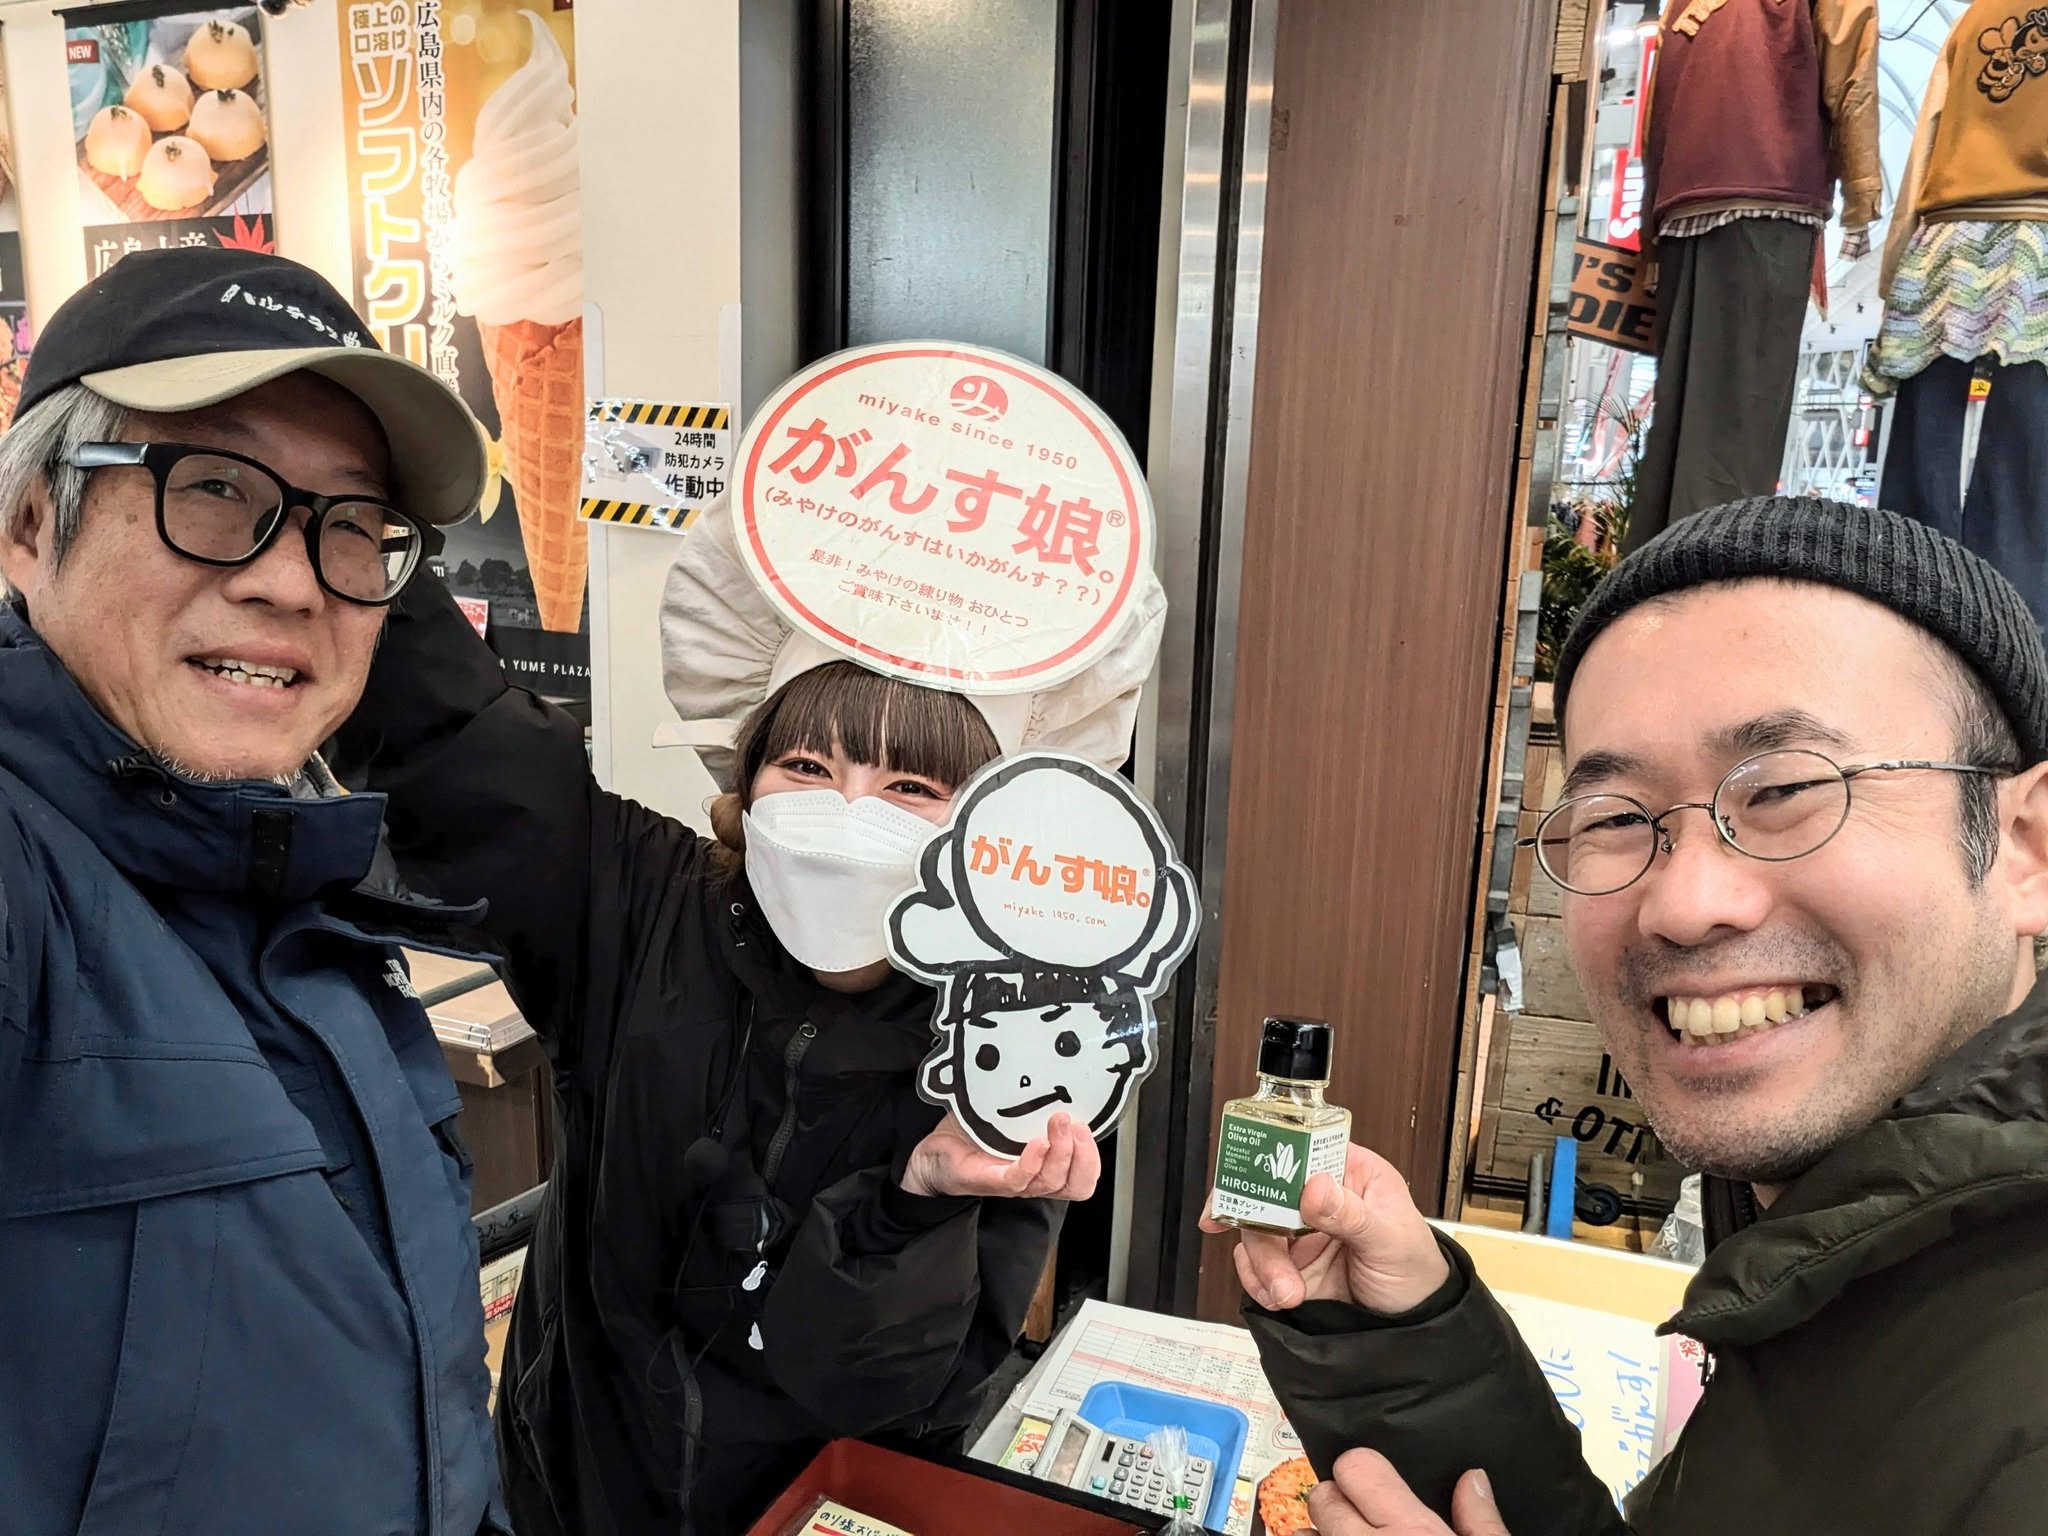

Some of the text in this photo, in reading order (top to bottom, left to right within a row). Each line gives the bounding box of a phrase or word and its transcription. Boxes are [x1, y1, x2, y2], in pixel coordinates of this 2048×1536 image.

[353, 4, 405, 29] 極上の
[68, 45, 92, 59] NEW
[355, 30, 406, 53] 口溶け
[675, 432, 716, 449] 24時間
[858, 393, 1077, 470] miyake since 1950
[664, 452, 725, 471] 防犯カメラ
[664, 474, 724, 499] 作動中
[968, 599, 1029, 629] おひとつ
[513, 659, 546, 673] YUME
[553, 664, 591, 678] PLAZA
[1003, 902, 1044, 917] miyake
[1534, 1096, 1564, 1126] &
[1227, 1131, 1261, 1147] Olive Oil
[1229, 1123, 1267, 1139] Extra Virgin
[1221, 1174, 1288, 1202] HIROSHIMA
